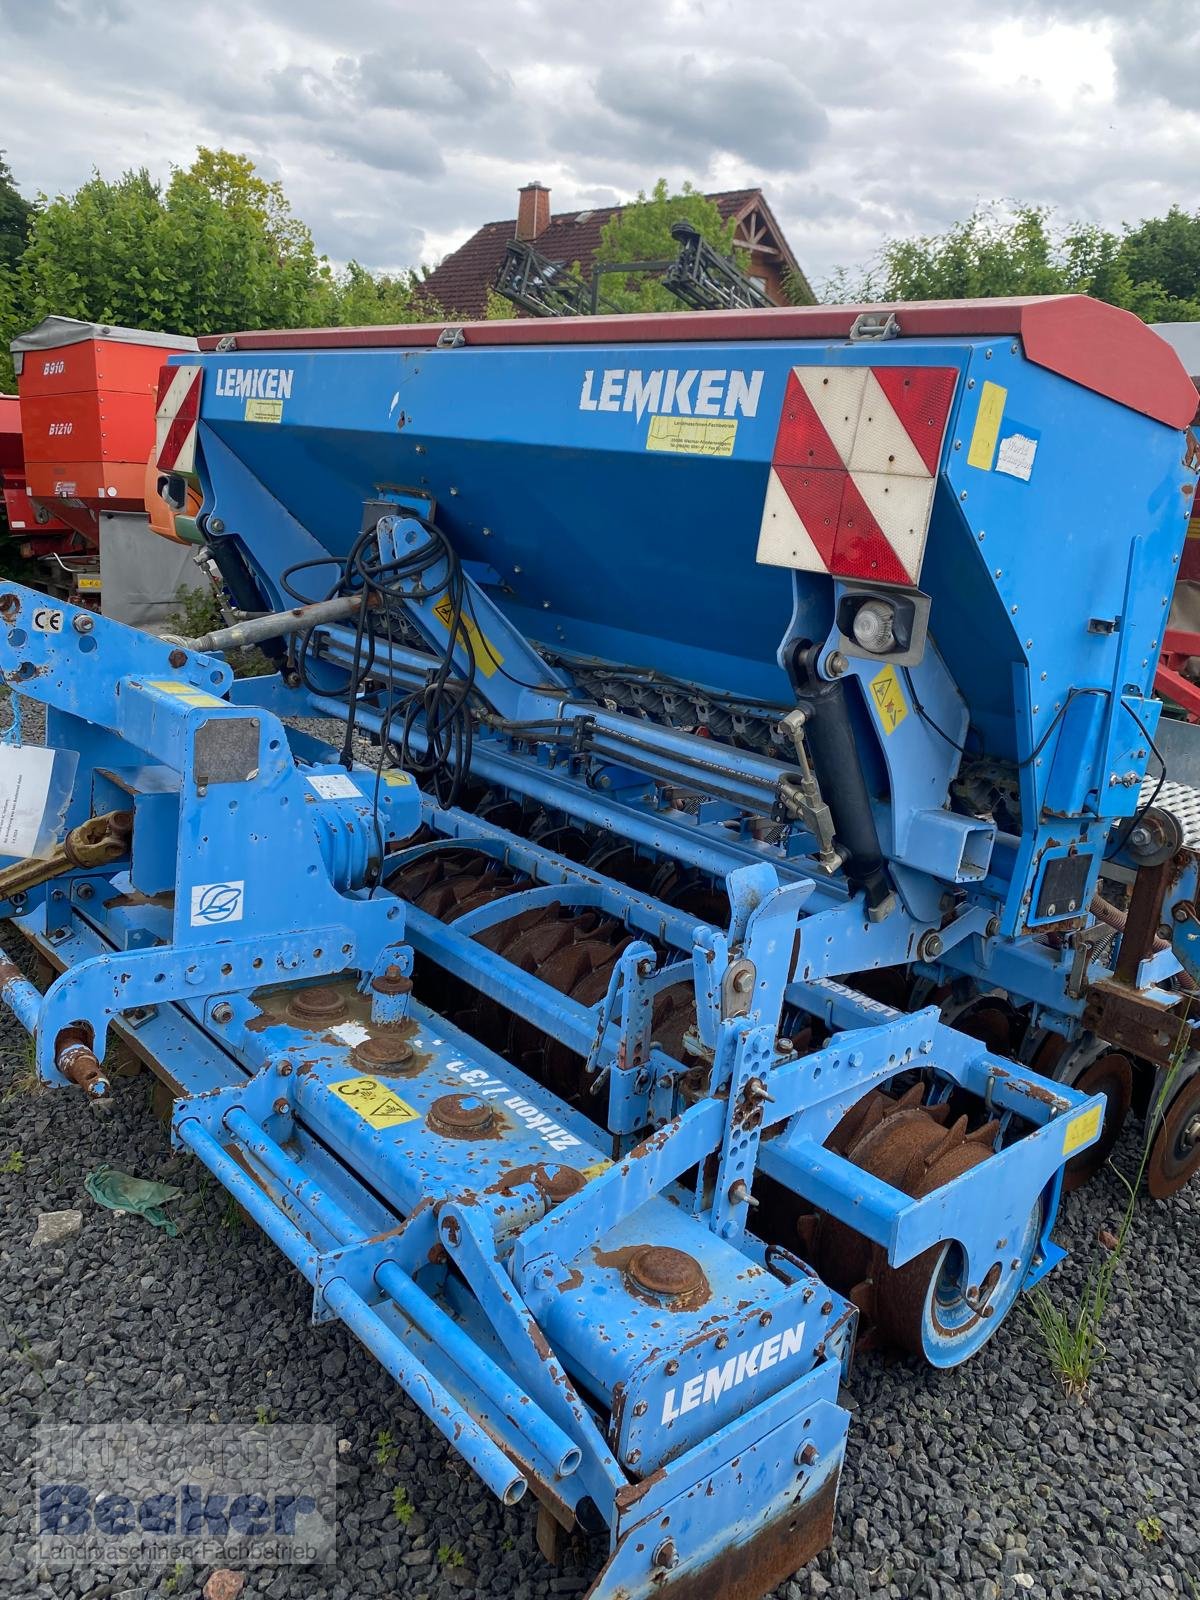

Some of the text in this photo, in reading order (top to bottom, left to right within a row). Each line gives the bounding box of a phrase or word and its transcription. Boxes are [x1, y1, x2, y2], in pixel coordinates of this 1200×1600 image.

[43, 361, 65, 376] B910
[215, 368, 294, 404] LEMKEN
[579, 369, 765, 425] LEMKEN
[49, 423, 73, 435] B1210
[504, 1096, 582, 1152] Zirkon
[661, 1321, 806, 1425] LEMKEN
